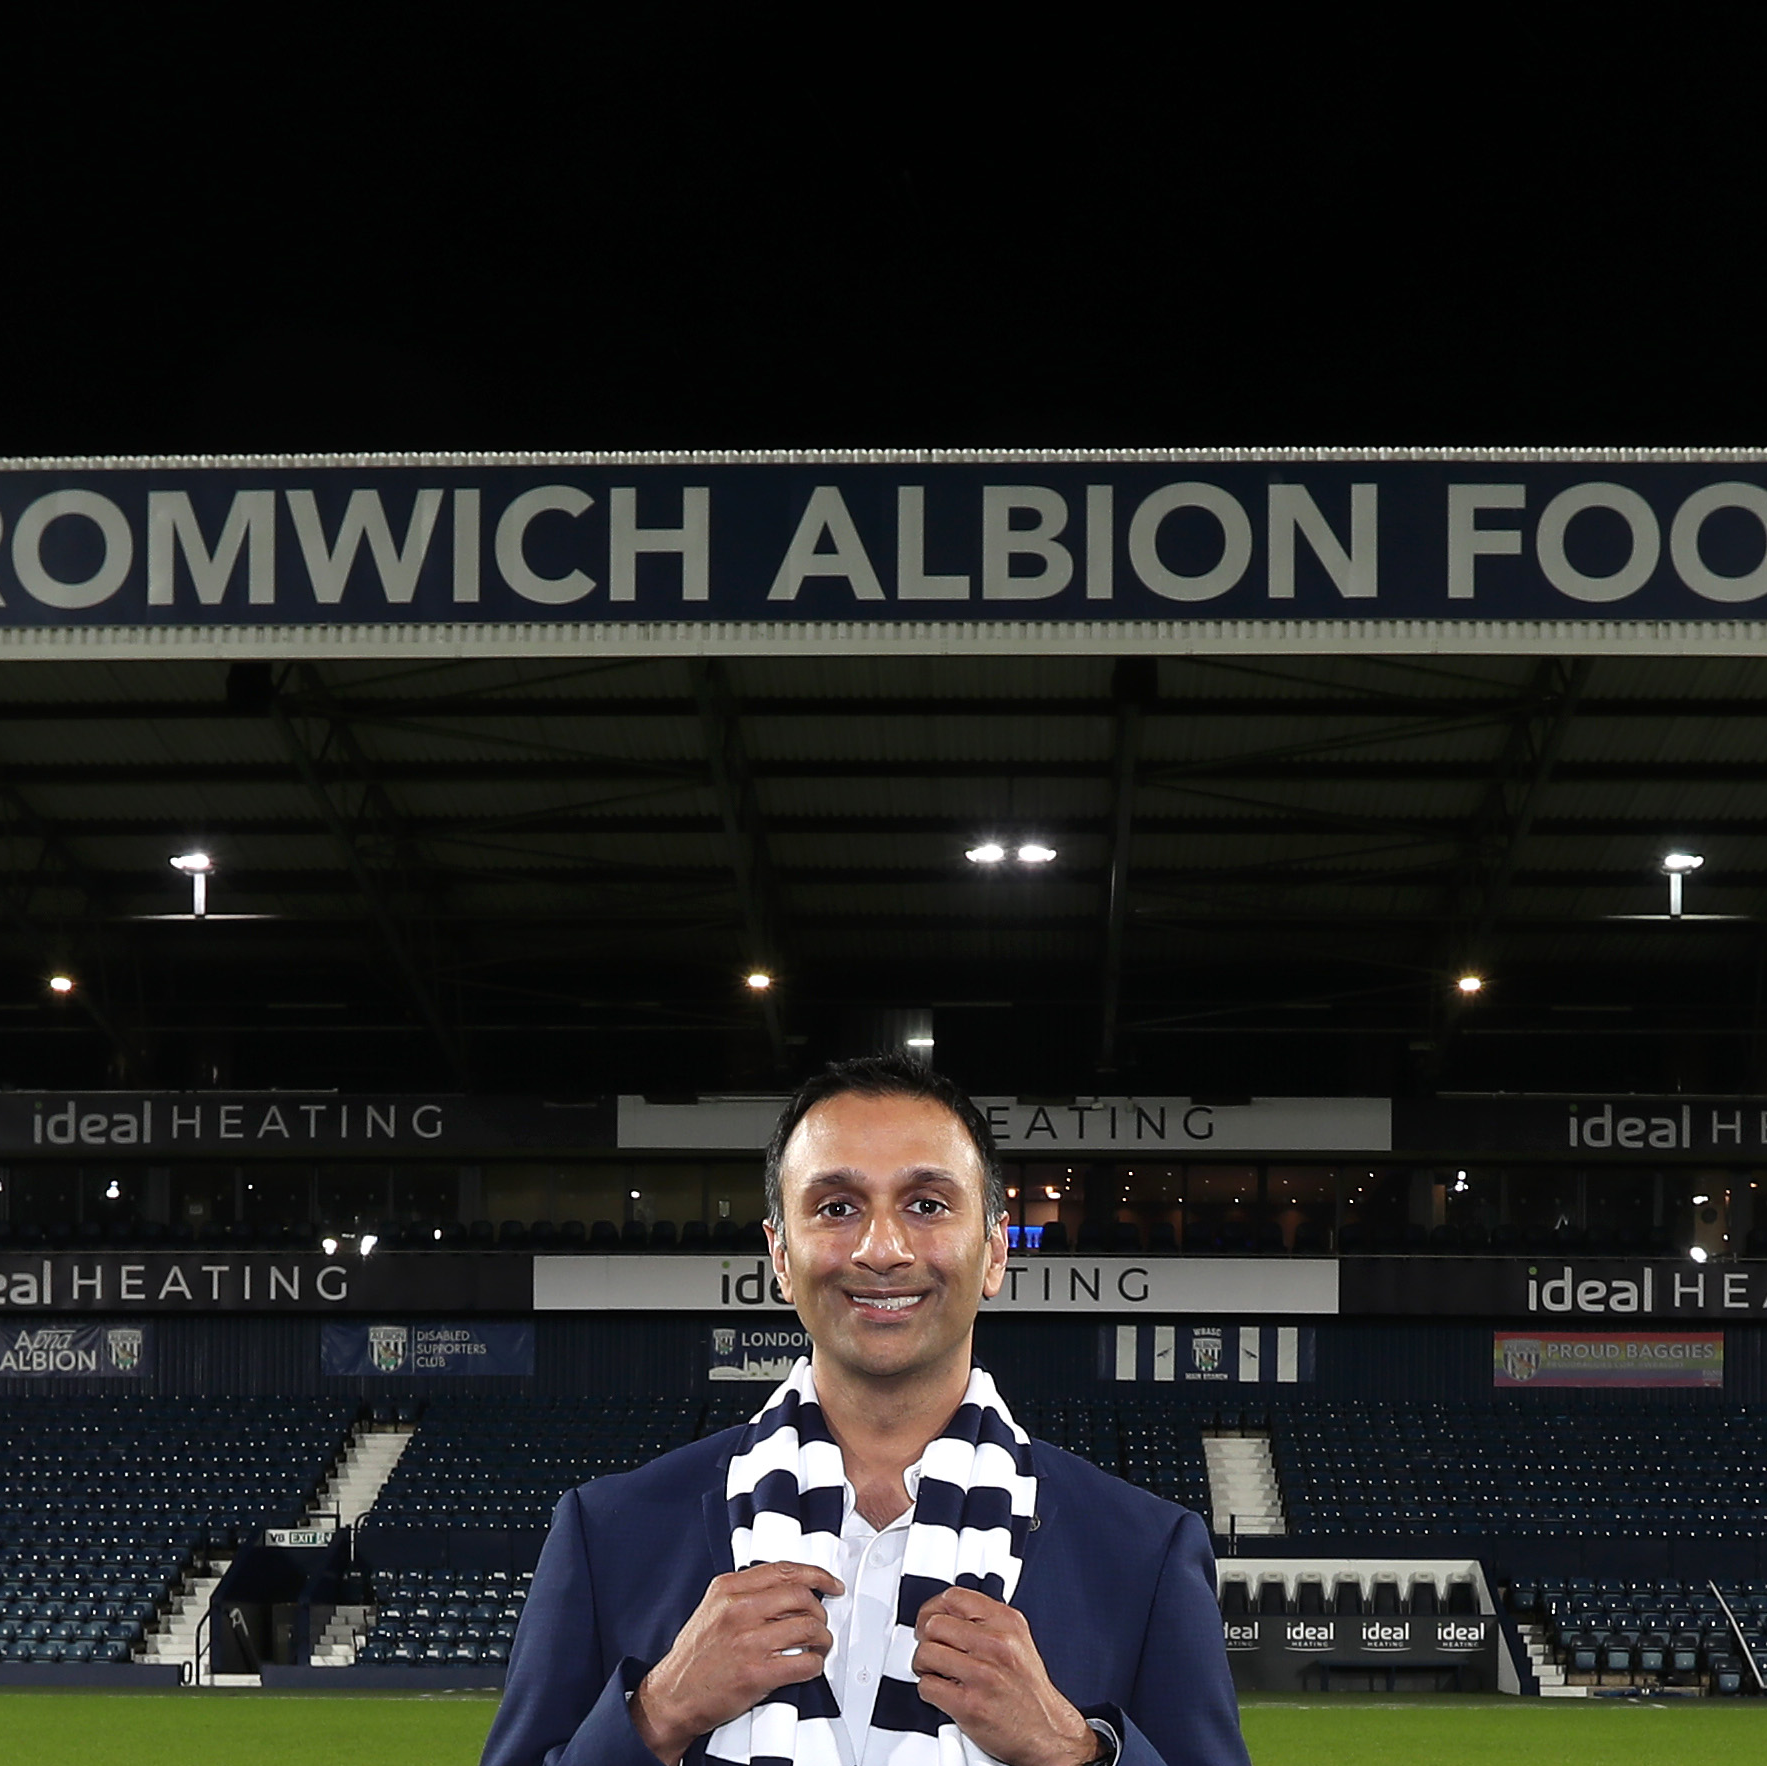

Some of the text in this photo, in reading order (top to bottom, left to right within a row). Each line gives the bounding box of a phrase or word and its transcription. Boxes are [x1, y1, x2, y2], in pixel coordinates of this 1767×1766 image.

[767, 483, 1379, 604] ALBION
[34, 1099, 444, 1145] ideal HEATING
[992, 1106, 1216, 1141] EATING
[1570, 1103, 1690, 1149] ideal
[73, 1264, 350, 1301] HEATING
[721, 1260, 780, 1305] ide
[1528, 1266, 1652, 1312] ideal
[15, 1330, 75, 1360] Apna
[417, 1331, 469, 1341] DISABLED
[417, 1344, 487, 1354] SUPPORTERS
[1547, 1344, 1619, 1358] PROUD
[1627, 1344, 1714, 1358] BAGGIES
[0, 1350, 96, 1371] ALBION
[417, 1357, 445, 1367] CLUB
[291, 1534, 314, 1543] EXIT
[1286, 1622, 1334, 1640] ideal
[1362, 1622, 1410, 1640] ideal
[1437, 1622, 1485, 1640] ideal
